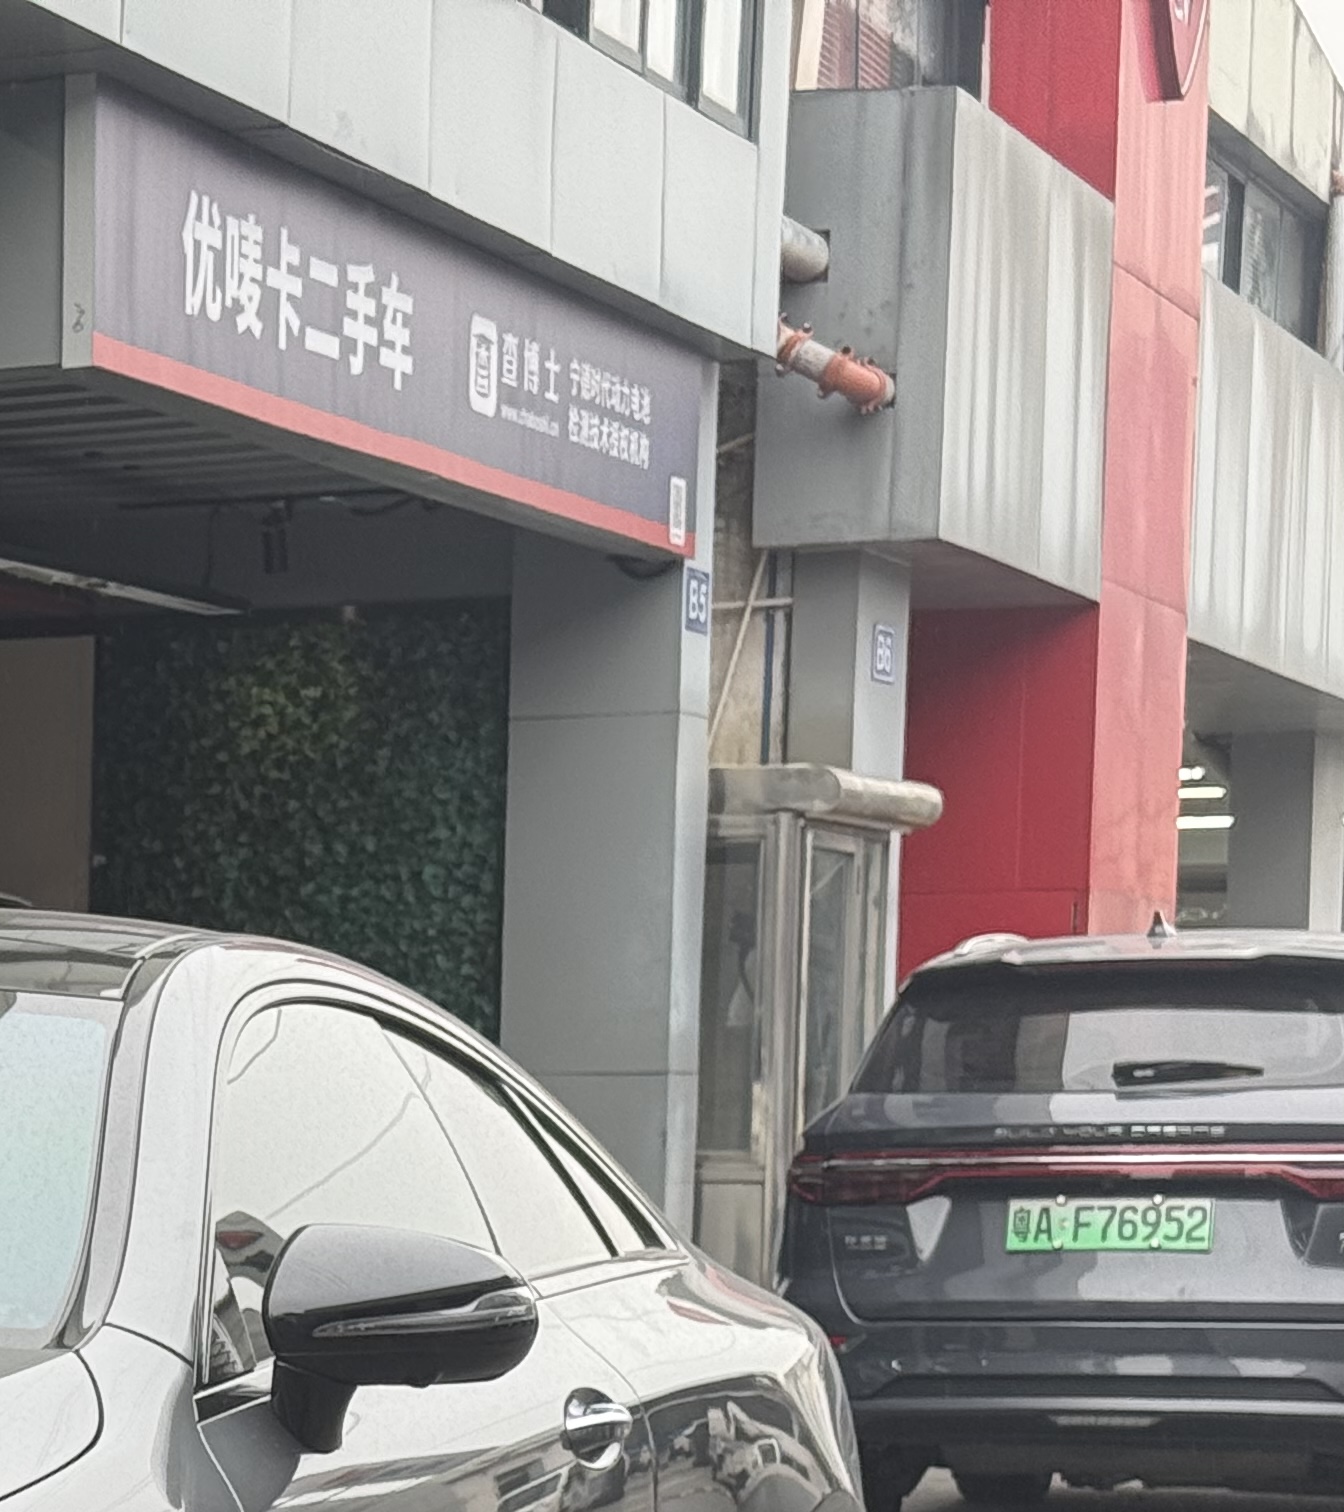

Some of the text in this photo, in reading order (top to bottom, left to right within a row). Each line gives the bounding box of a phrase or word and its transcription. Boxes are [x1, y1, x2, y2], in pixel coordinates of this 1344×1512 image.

[182, 189, 413, 391] 优唛卡二手车
[501, 332, 561, 404] 查博士
[688, 578, 708, 622] B5
